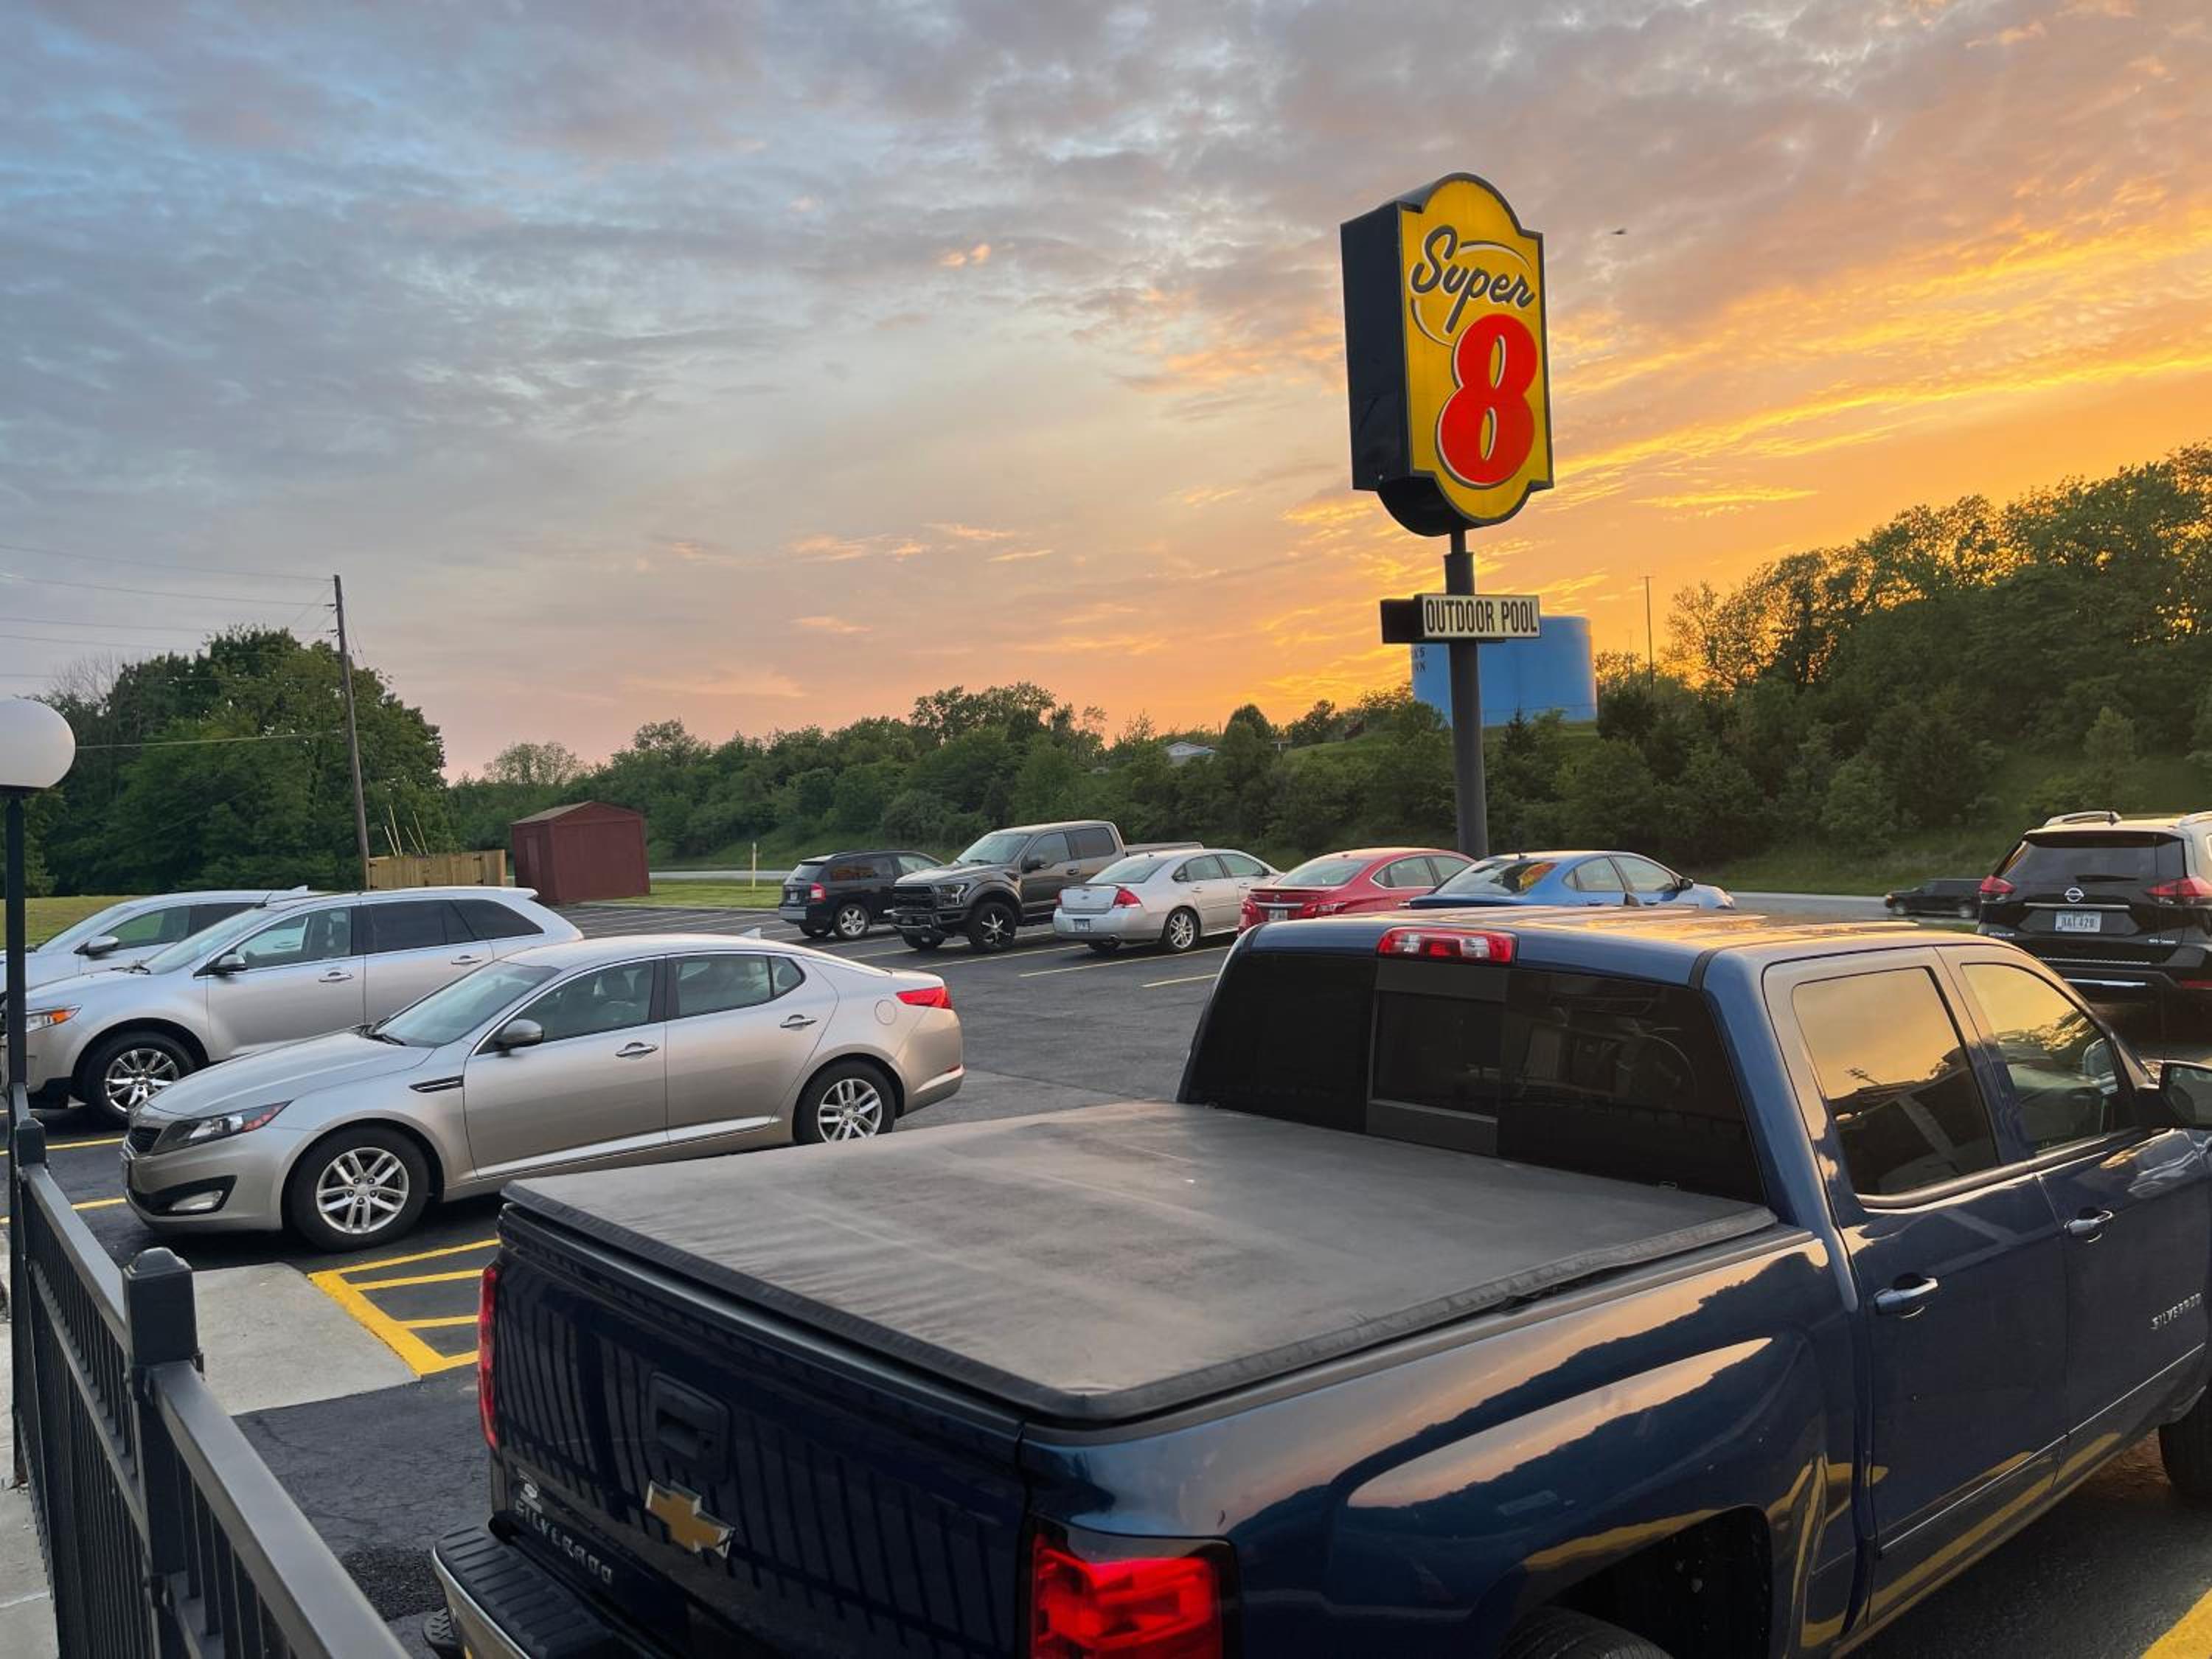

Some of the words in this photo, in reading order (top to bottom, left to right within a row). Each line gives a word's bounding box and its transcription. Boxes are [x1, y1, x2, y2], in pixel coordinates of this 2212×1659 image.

[1411, 224, 1534, 334] Super
[1436, 313, 1538, 490] 8
[1425, 600, 1495, 633] OUTDOOR
[1501, 600, 1537, 633] POOL
